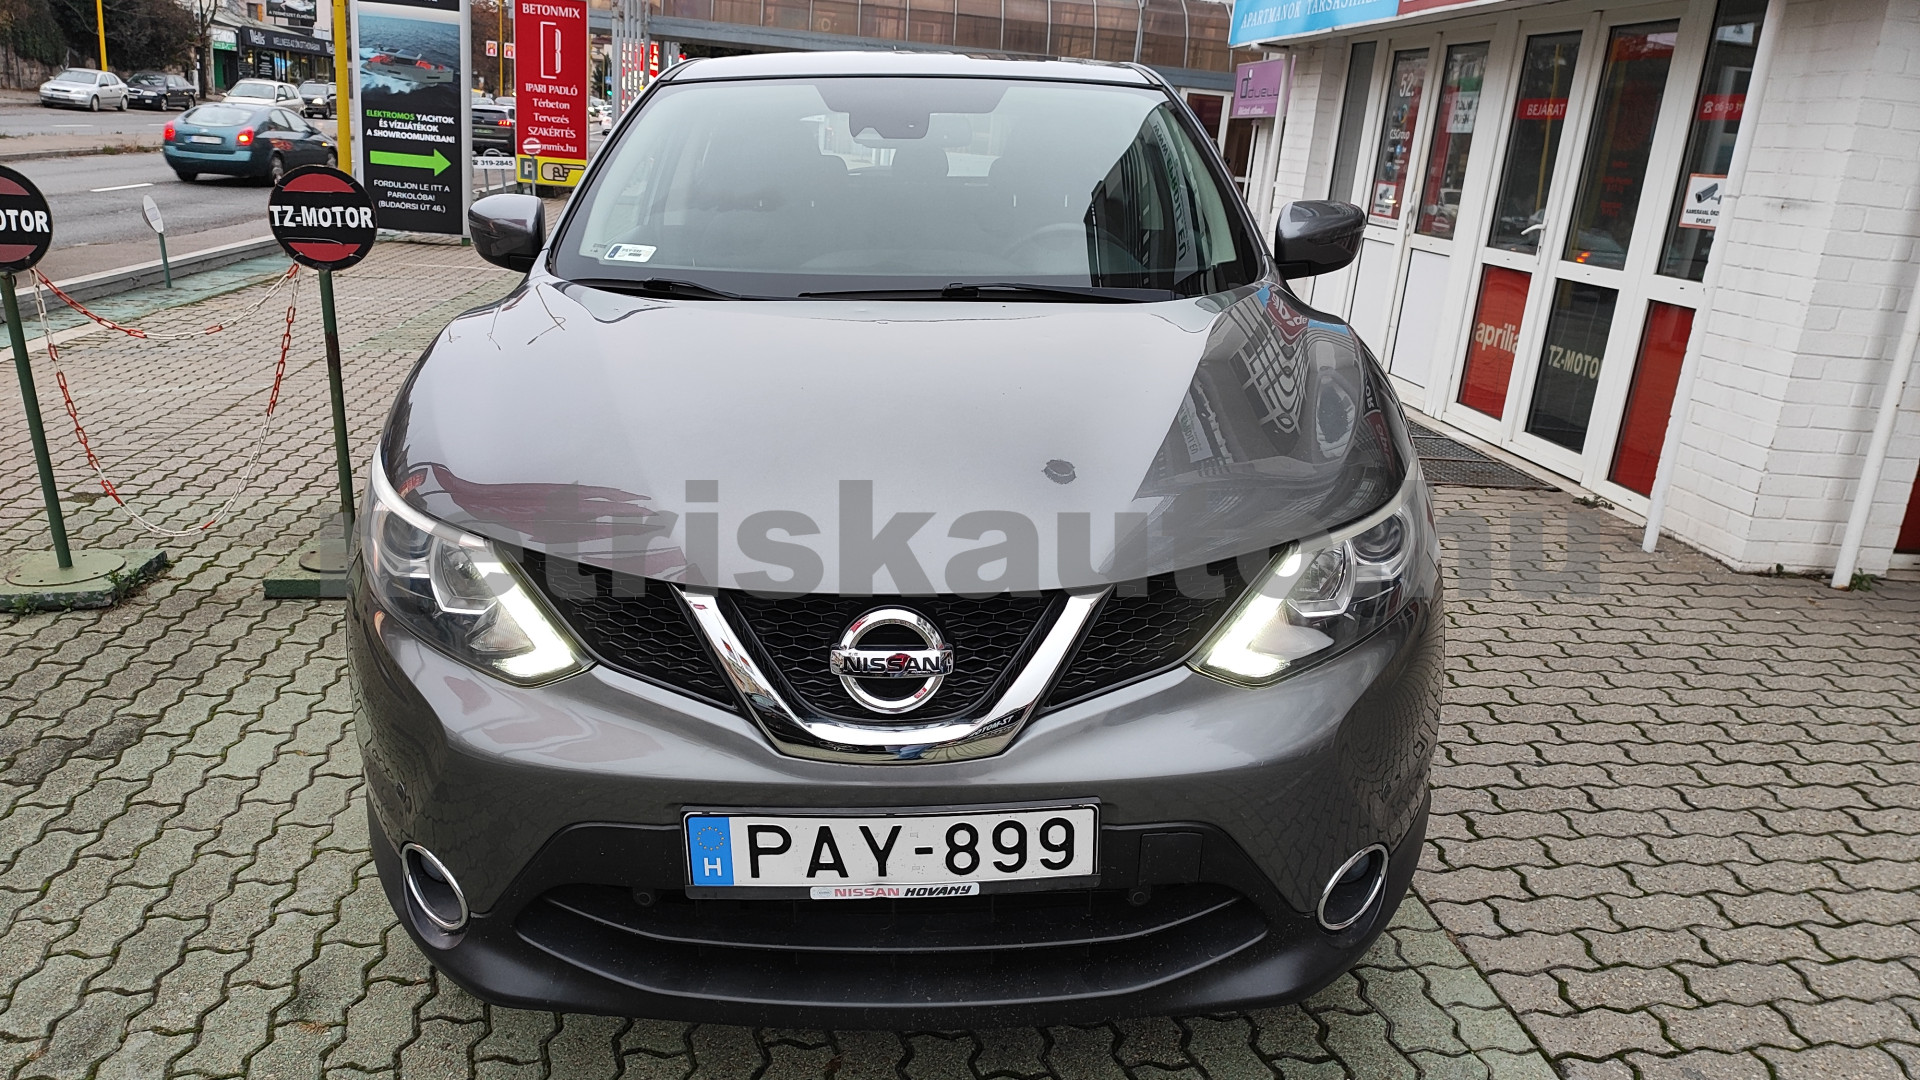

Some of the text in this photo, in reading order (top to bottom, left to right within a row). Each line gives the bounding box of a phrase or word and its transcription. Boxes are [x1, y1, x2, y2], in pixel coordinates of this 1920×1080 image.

[522, 3, 580, 19] BETONMIX
[1240, 1, 1301, 29] APARTMANOK
[525, 83, 578, 96] IPARI PADLÓ
[532, 98, 570, 110] Térbeton
[1526, 100, 1566, 116] BEJÁRAT
[366, 109, 455, 124] ELEKTROMOS YACHTOK
[533, 112, 570, 124] Tervezés
[379, 119, 388, 128] ÉS
[373, 129, 456, 143] SHOWROOMUNKBAN!
[527, 126, 576, 139] SZAKÉRTÉS
[540, 143, 578, 153] onmix.hu
[373, 180, 418, 190] FORDULJON
[430, 184, 442, 192] ITT
[387, 191, 436, 201] PARKOLÓBA!
[269, 205, 374, 229] TZ-MOTOR
[1548, 344, 1600, 379] TZ-MOTO
[843, 656, 941, 673] NISSAN
[703, 816, 1076, 880] H PAY-899
[834, 887, 900, 897] NISSAN
